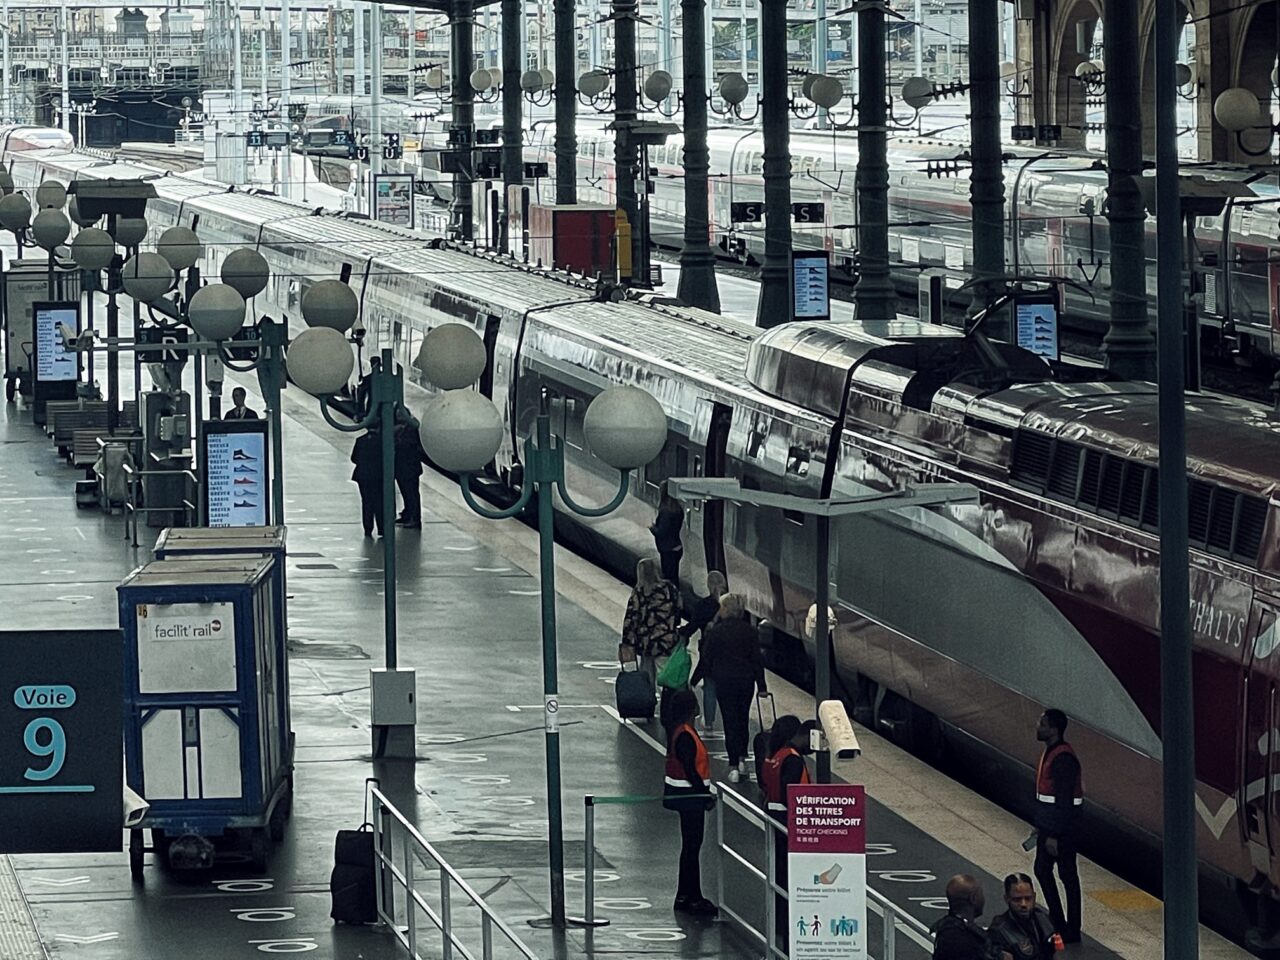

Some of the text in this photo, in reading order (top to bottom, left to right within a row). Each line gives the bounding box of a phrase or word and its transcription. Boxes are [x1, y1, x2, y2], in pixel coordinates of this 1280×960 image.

[385, 148, 394, 159] U
[530, 166, 538, 177] T
[746, 207, 756, 222] S
[800, 207, 810, 222] S
[162, 336, 180, 361] R
[22, 688, 68, 706] Voie
[23, 717, 67, 781] 9
[796, 795, 856, 806] VÉRIFICATION
[796, 806, 843, 816] DES TITRES
[796, 817, 862, 827] DE TRANSPORT
[816, 828, 849, 836] CHECKING
